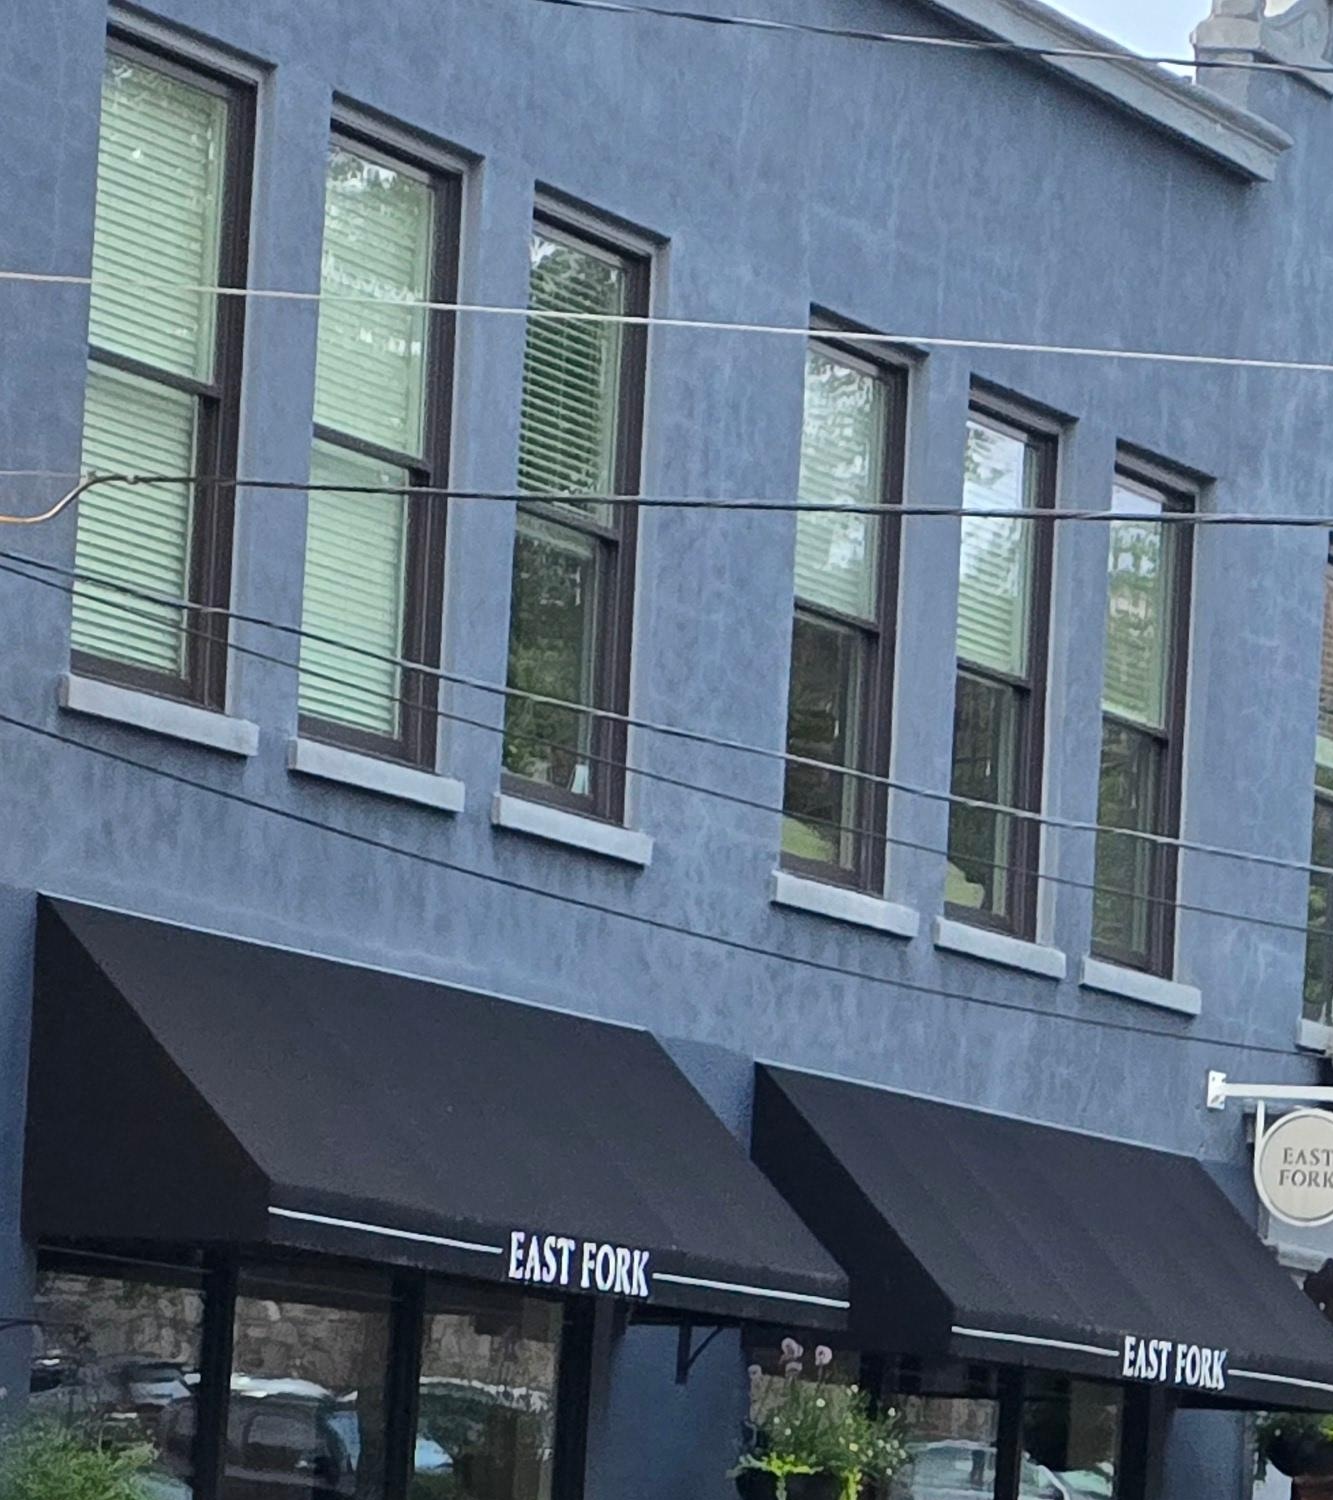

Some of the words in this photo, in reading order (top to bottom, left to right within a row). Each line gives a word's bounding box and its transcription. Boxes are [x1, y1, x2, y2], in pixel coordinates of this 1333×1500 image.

[508, 1231, 576, 1285] EAST
[580, 1242, 649, 1297] FORK
[1122, 1335, 1172, 1382] EAST
[1175, 1343, 1229, 1391] FORK
